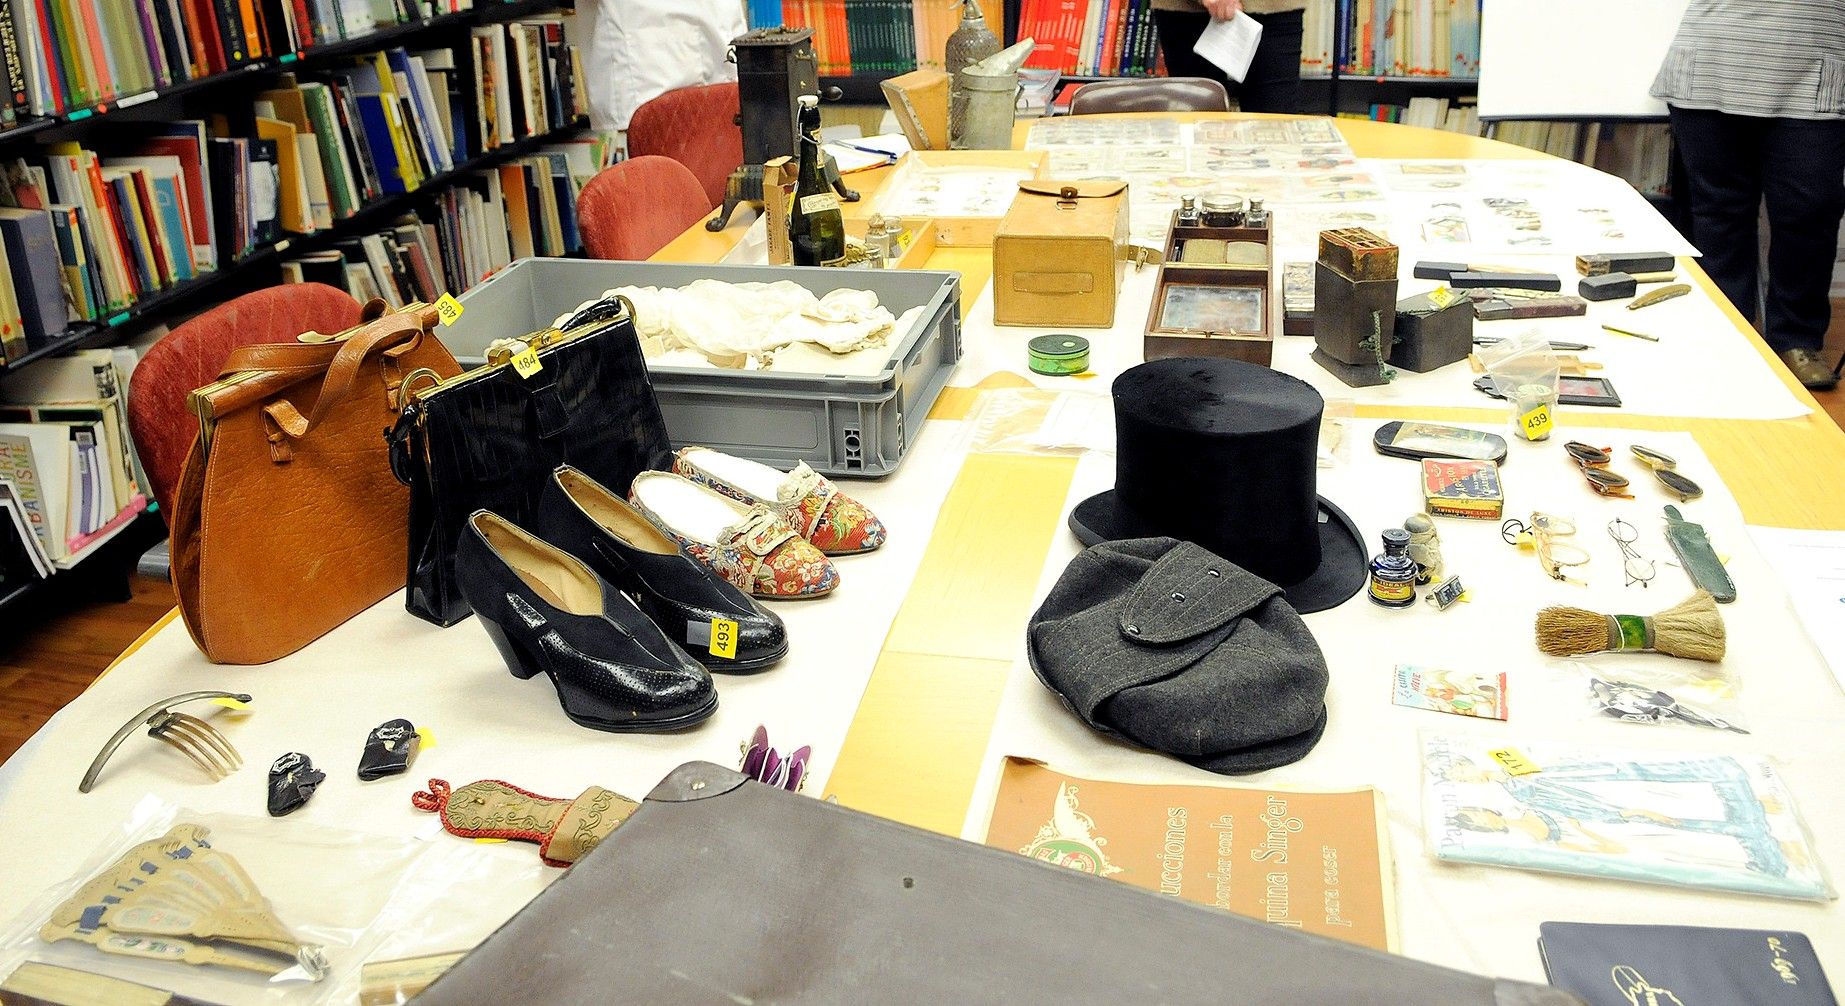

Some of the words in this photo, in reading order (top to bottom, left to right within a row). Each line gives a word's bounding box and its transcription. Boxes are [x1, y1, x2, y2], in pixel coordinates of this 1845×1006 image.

[437, 300, 457, 318] 485
[518, 353, 536, 370] 484
[1528, 412, 1547, 428] 439
[716, 622, 730, 652] 493
[1495, 750, 1523, 770] 172
[1250, 795, 1304, 864] Singer
[1156, 806, 1188, 897] ucciones
[1322, 845, 1339, 886] coser
[1324, 889, 1352, 928] para
